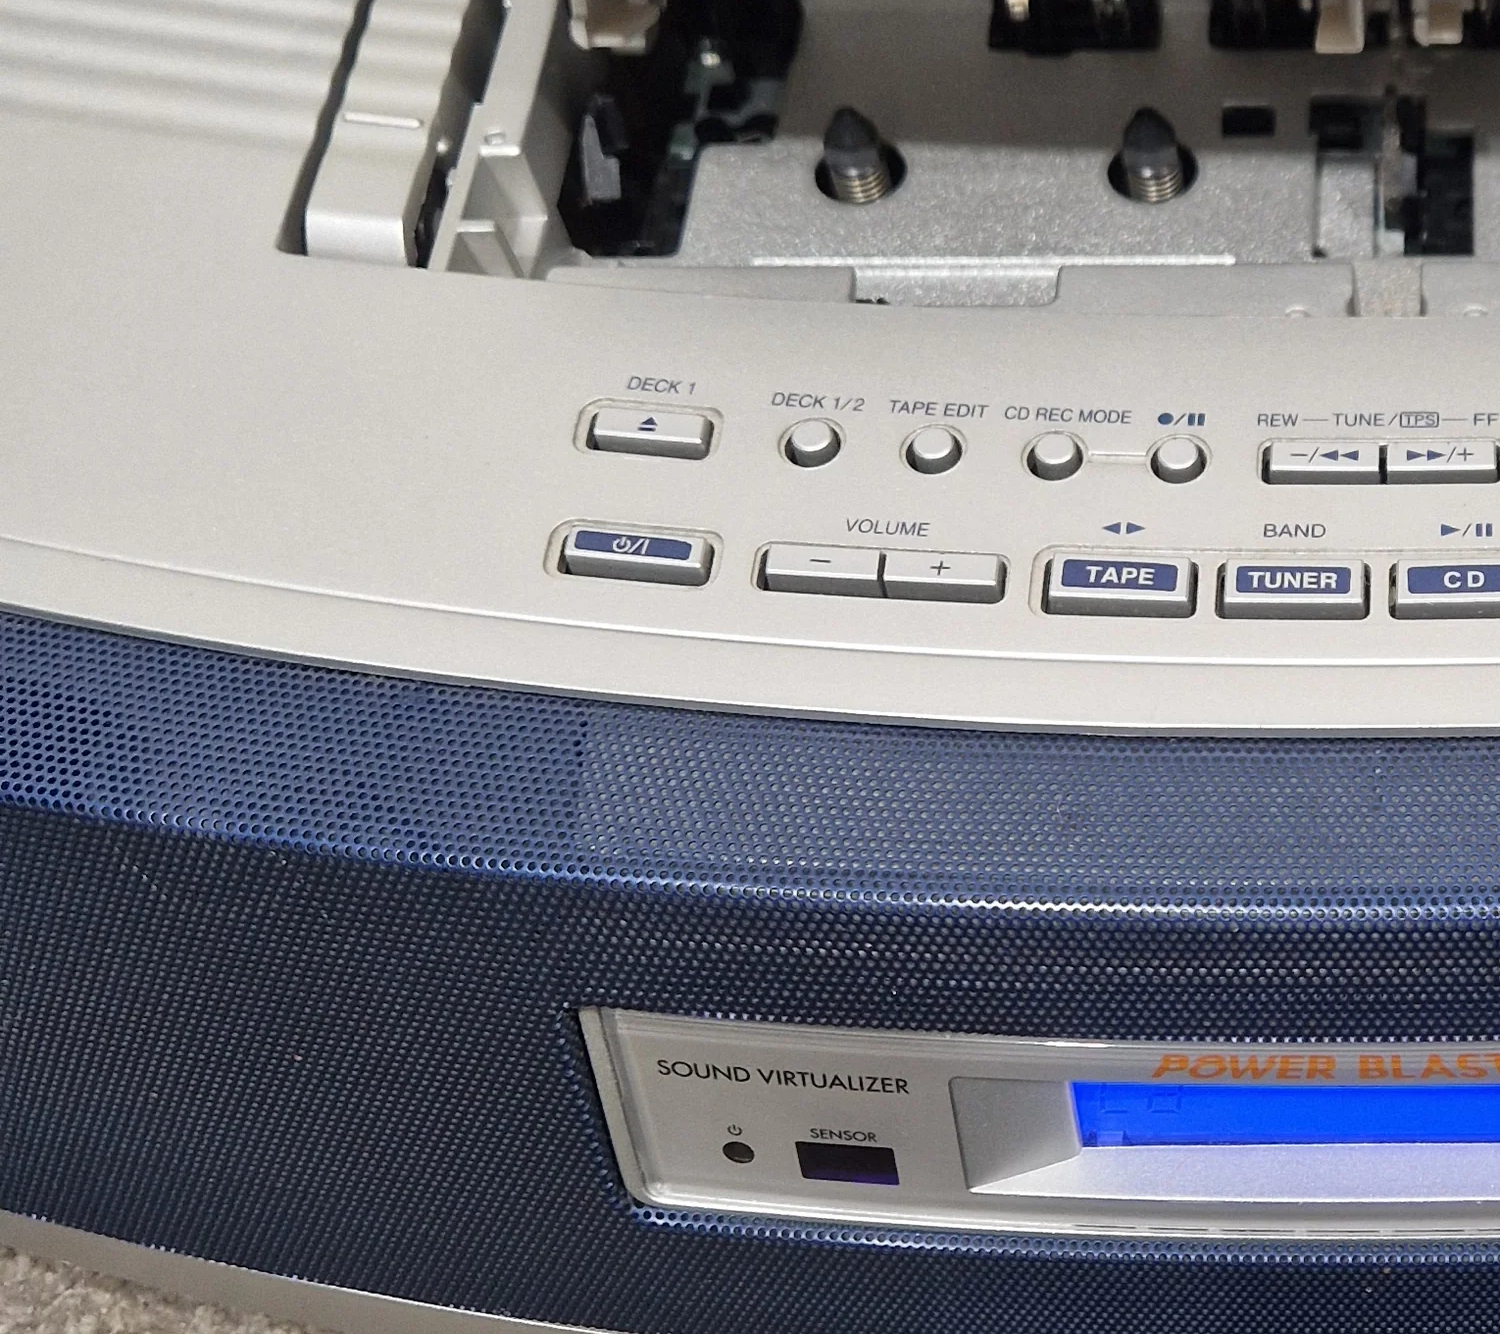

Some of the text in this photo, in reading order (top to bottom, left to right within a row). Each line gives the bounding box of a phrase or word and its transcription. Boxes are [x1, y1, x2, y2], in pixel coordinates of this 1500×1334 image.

[626, 375, 696, 396] DECK 1
[771, 392, 865, 412] DECK 1/2
[890, 399, 990, 418] TAPE EDIT
[1004, 405, 1132, 424] CD REC MODE
[1257, 413, 1299, 428] REW
[1473, 412, 1499, 427] FF
[846, 518, 931, 537] VOLUME
[1263, 523, 1326, 539] BAND
[1087, 565, 1155, 586] TAPE
[1247, 571, 1338, 589] TUNER
[1443, 571, 1485, 589] CD
[1152, 1054, 1336, 1079] POWER
[657, 1059, 910, 1095] SOUND VIRTUALIZER
[810, 1128, 878, 1142] SENSOR
